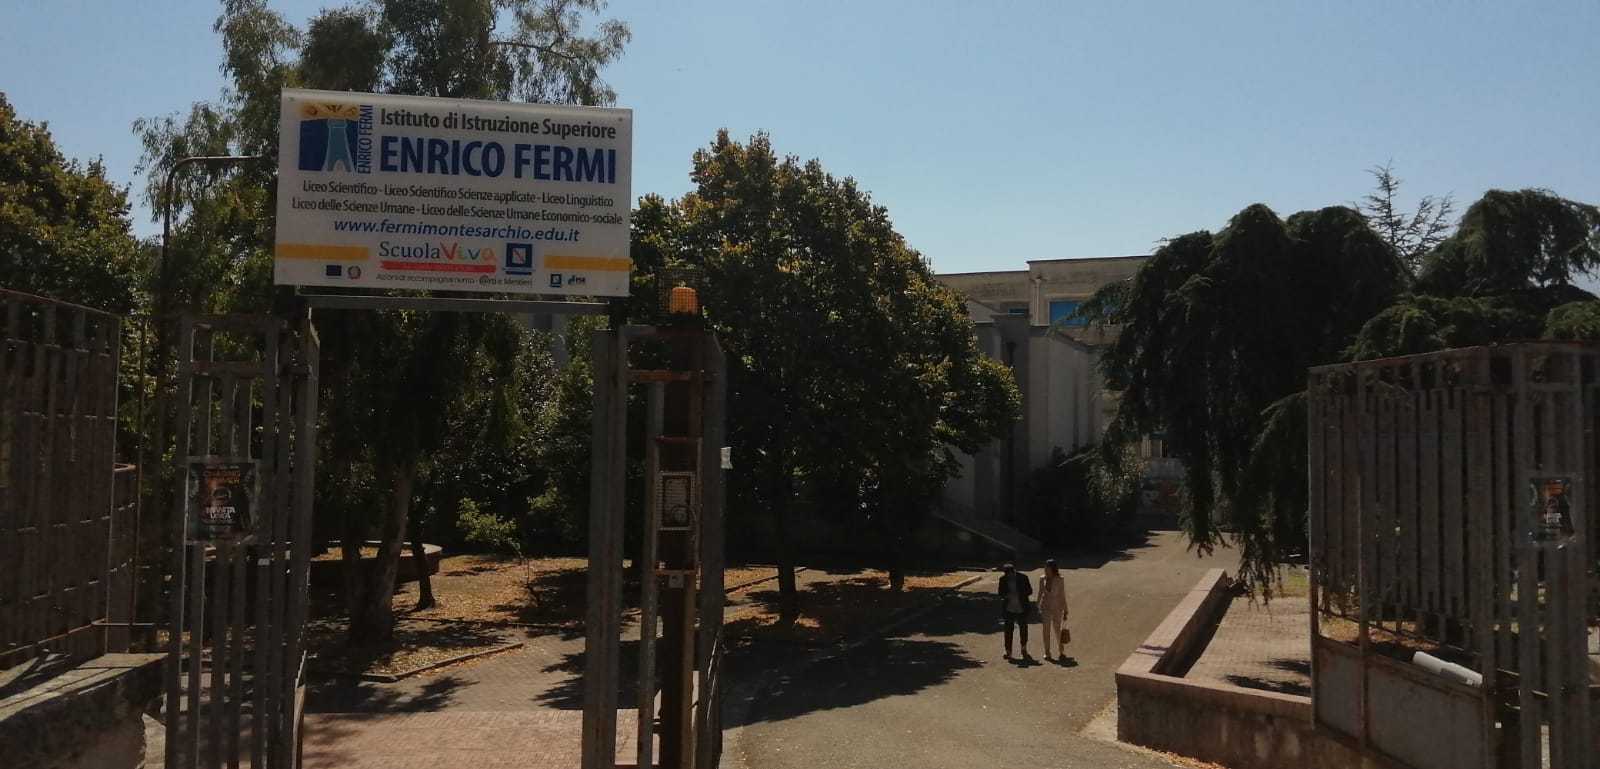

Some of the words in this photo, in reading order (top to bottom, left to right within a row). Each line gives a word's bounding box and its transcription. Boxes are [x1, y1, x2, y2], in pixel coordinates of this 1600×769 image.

[360, 104, 373, 136] FERMI
[380, 108, 439, 128] Istituto
[443, 111, 458, 129] di
[461, 113, 540, 134] Istruzione
[542, 118, 616, 140] Superiore
[358, 136, 372, 174] ENRICO
[380, 135, 505, 178] ENRICO
[514, 143, 616, 184] FERMI
[303, 180, 327, 193] Liceo
[329, 181, 377, 196] Scientifico
[384, 183, 408, 196] Liceo
[409, 185, 457, 199] Scientifico
[458, 187, 493, 201] Scienze
[494, 191, 536, 204] applicate
[542, 192, 565, 206] Liceo
[566, 193, 614, 209] Linguistico
[292, 197, 317, 210] Liceo
[318, 197, 342, 211] delle
[343, 199, 379, 213] Scienze
[380, 201, 415, 215] Umane
[421, 203, 446, 216] Liceo
[446, 204, 470, 217] delle
[470, 206, 505, 219] Scienze
[506, 208, 541, 221] Umane
[541, 210, 623, 225] Economico-sociale
[334, 218, 580, 242] www.fermimontesarchio.edu.it
